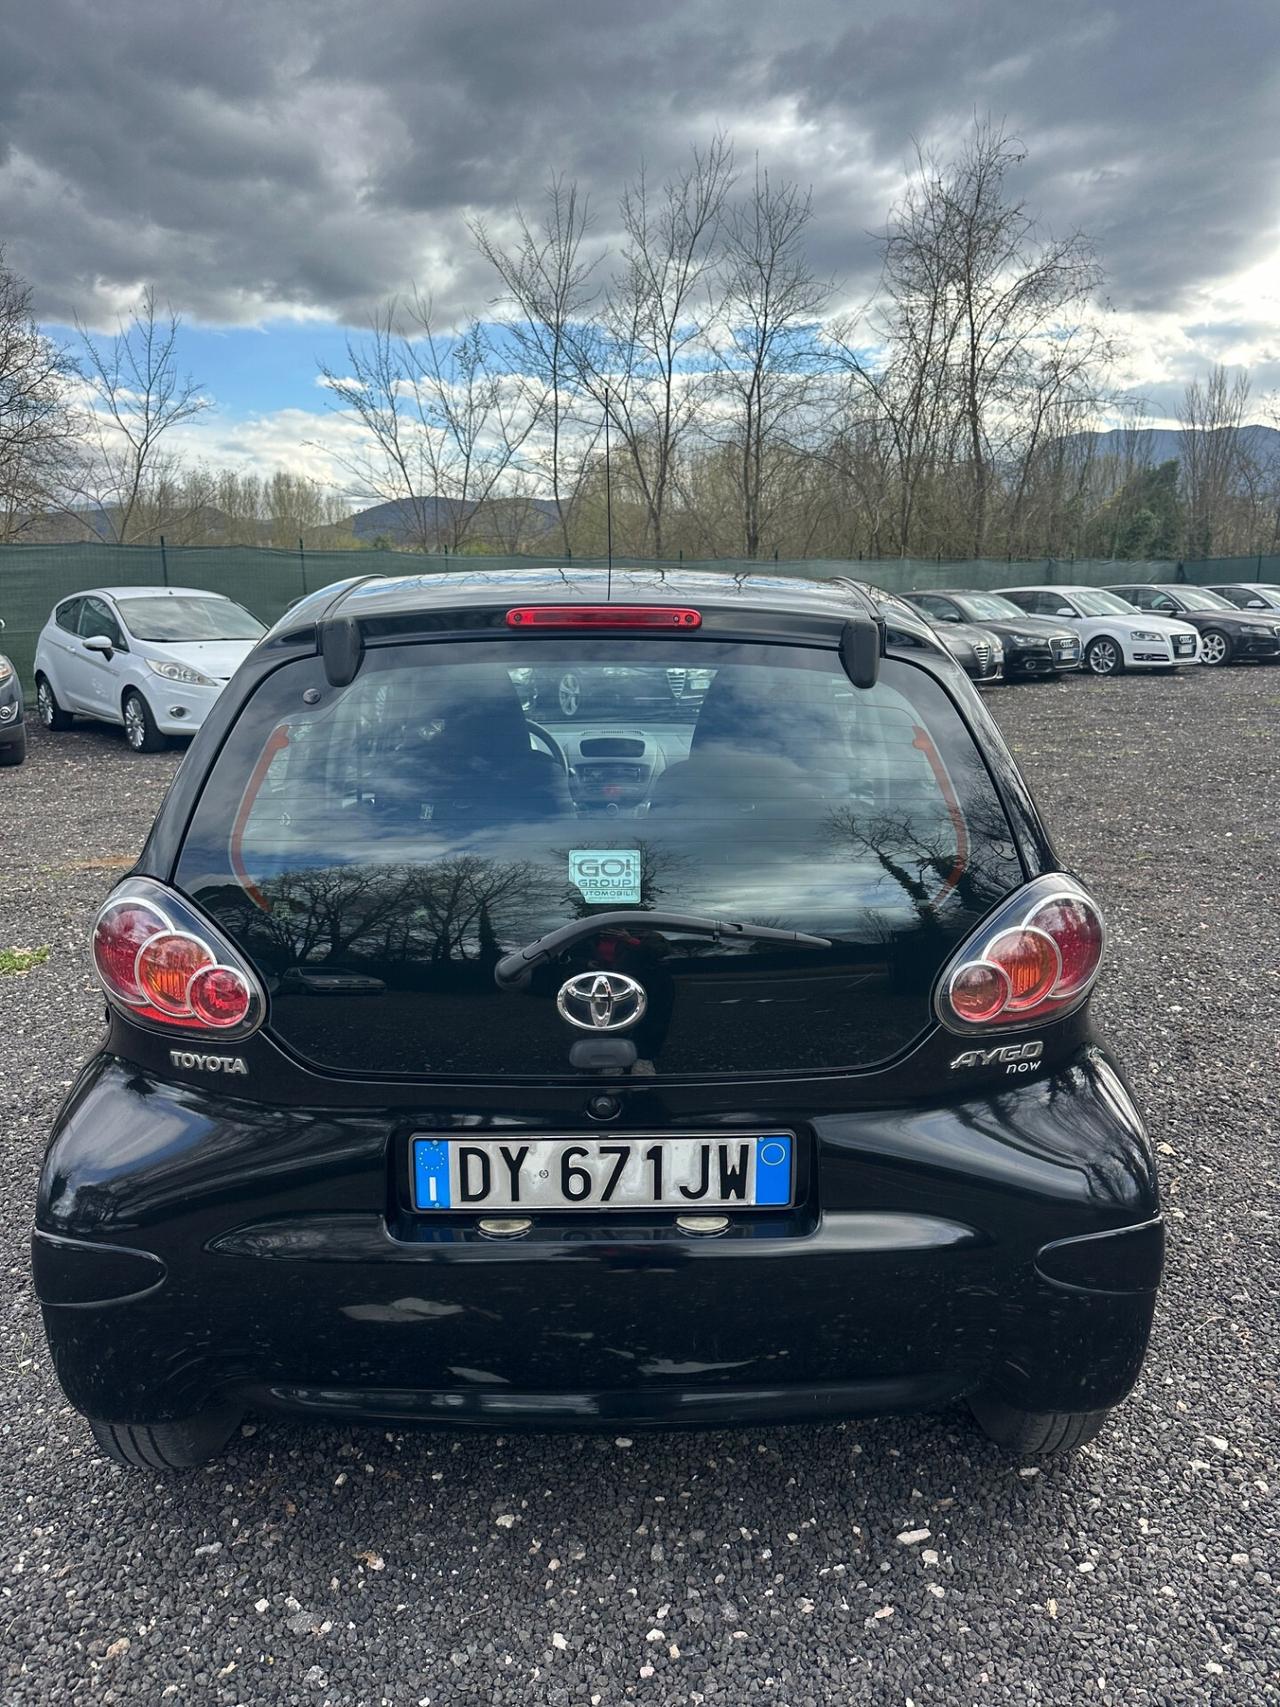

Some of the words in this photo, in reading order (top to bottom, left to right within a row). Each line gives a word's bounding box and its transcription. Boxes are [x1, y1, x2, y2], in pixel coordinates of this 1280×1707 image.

[577, 858, 632, 878] GO!
[578, 879, 632, 888] GROUP
[170, 1050, 248, 1075] TOYOTA
[950, 1041, 1044, 1069] AYGO
[1006, 1060, 1042, 1074] now
[459, 1145, 530, 1202] DY
[560, 1144, 750, 1202] 671JW
